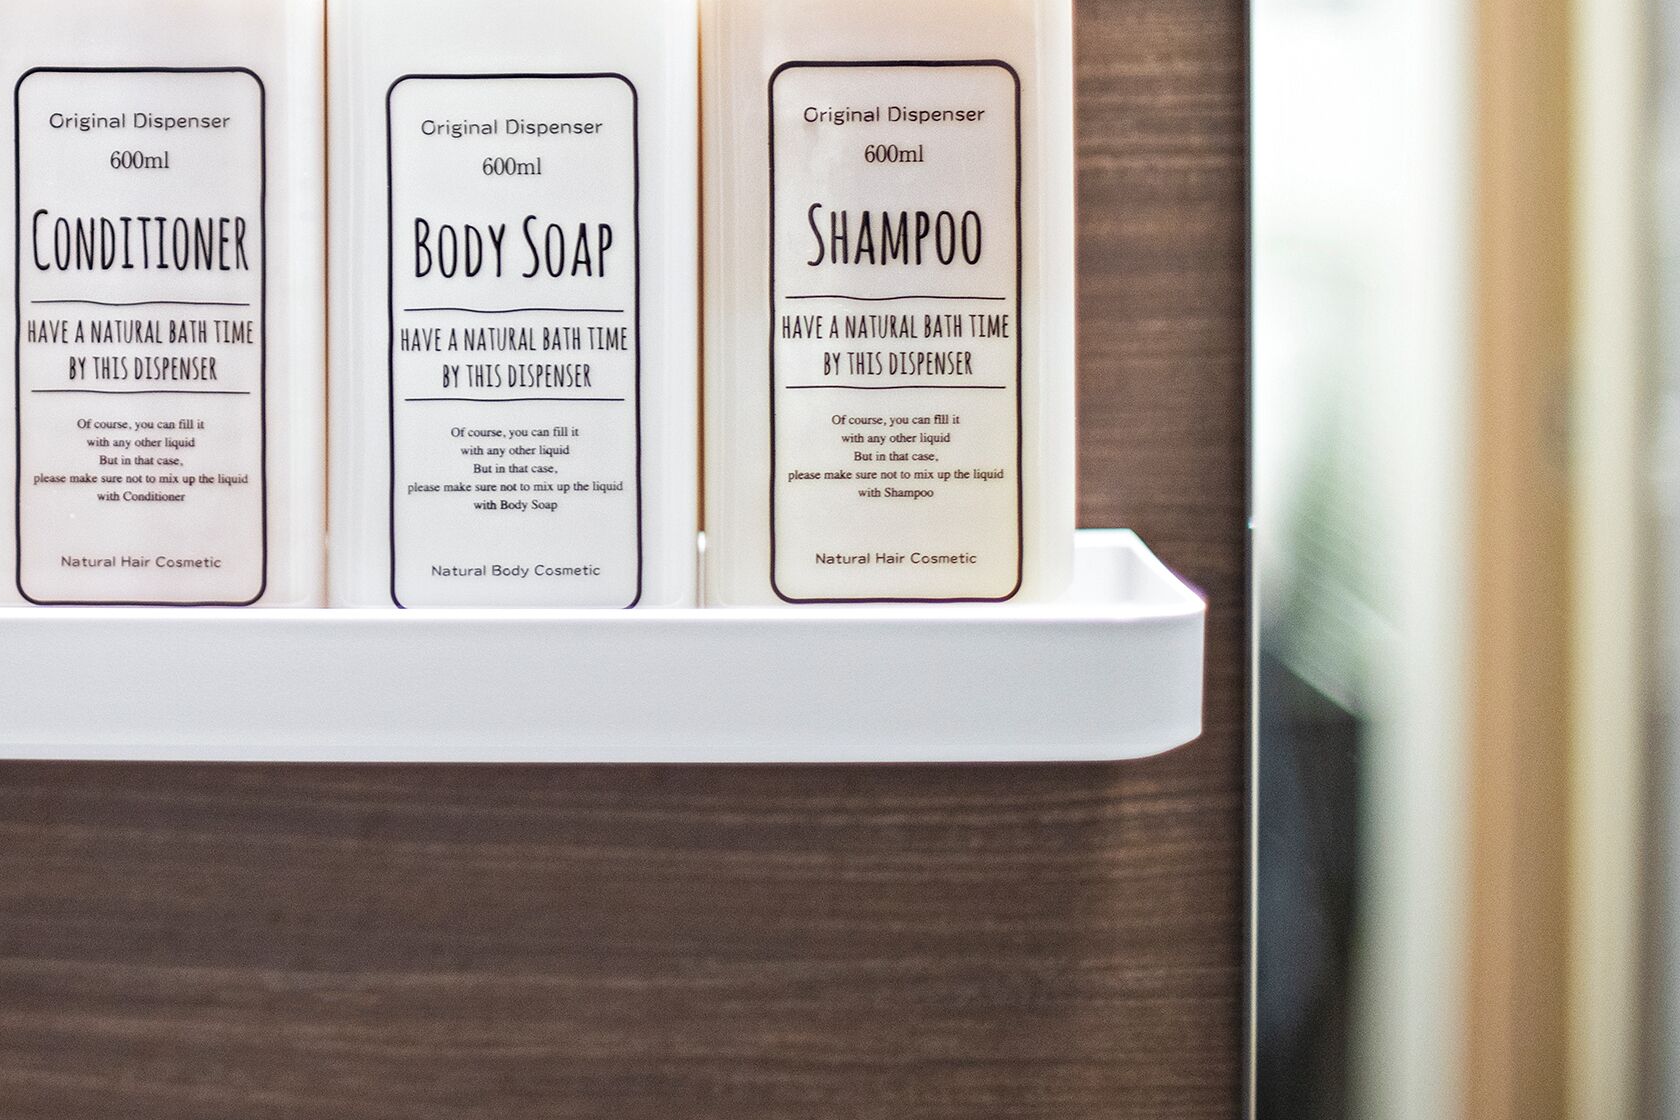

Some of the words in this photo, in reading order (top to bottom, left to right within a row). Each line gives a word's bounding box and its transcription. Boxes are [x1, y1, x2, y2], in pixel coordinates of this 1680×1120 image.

[49, 112, 126, 132] Original
[133, 112, 231, 132] Dispenser
[803, 106, 880, 126] Original
[887, 105, 986, 125] Dispenser
[421, 119, 498, 139] Original
[505, 118, 604, 137] Dispenser
[109, 150, 170, 170] 600ml
[864, 143, 925, 164] 600ml
[482, 156, 542, 176] 600ml
[32, 208, 249, 272] CONDITIONER
[807, 202, 983, 267] SHAMPOO
[414, 217, 506, 279] BODY
[521, 214, 613, 279] SOAP
[27, 319, 69, 344] HAVE
[74, 319, 85, 344] A
[90, 319, 163, 344] NATURAL
[168, 319, 208, 344] BATH
[213, 319, 254, 345] TIME
[782, 315, 823, 340] HAVE
[829, 315, 839, 339] A
[845, 314, 919, 339] NATURAL
[923, 313, 963, 339] BATH
[968, 313, 1010, 339] TIME
[400, 327, 442, 352] HAVE
[447, 327, 458, 352] A
[463, 327, 537, 352] NATURAL
[542, 326, 581, 351] BATH
[587, 326, 628, 351] TIME
[69, 355, 87, 381] BY
[92, 356, 128, 381] THIS
[134, 356, 218, 381] DISPENSER
[823, 351, 841, 376] BY
[846, 351, 883, 376] THIS
[888, 350, 973, 376] DISPENSER
[442, 364, 460, 389] BY
[465, 363, 502, 388] THIS
[507, 363, 592, 388] DISPENSER
[76, 418, 92, 430] Of
[134, 421, 155, 432] you
[156, 421, 176, 430] can
[178, 418, 195, 430] fill
[196, 419, 205, 430] it
[831, 414, 848, 426] Of
[888, 416, 910, 428] you
[911, 416, 931, 425] can
[933, 413, 950, 425] fill
[952, 414, 961, 425] it
[450, 426, 466, 438] Of
[508, 429, 529, 440] you
[530, 429, 550, 437] can
[552, 426, 569, 437] fill
[570, 426, 580, 437] it
[841, 432, 865, 444] with
[866, 435, 887, 446] any
[888, 432, 918, 444] other
[919, 432, 951, 446] liquid
[86, 436, 111, 448] with
[112, 439, 132, 450] any
[134, 436, 163, 448] other
[164, 437, 196, 451] liquid
[460, 445, 485, 456] with
[486, 447, 506, 458] any
[508, 445, 537, 456] other
[538, 444, 571, 458] liquid
[98, 454, 119, 466] But
[120, 454, 132, 466] in
[134, 455, 155, 466] that
[853, 450, 874, 462] But
[875, 450, 887, 462] in
[888, 450, 910, 462] that
[473, 463, 493, 474] But
[495, 463, 506, 474] in
[508, 463, 529, 474] that
[787, 469, 822, 483] please
[823, 469, 853, 480] make
[855, 471, 878, 480] sure
[880, 470, 898, 480] not
[900, 470, 912, 480] to
[913, 468, 935, 480] mix
[936, 471, 952, 482] up
[953, 468, 971, 480] the
[973, 468, 1005, 482] liquid
[33, 472, 67, 486] please
[69, 472, 98, 484] make
[100, 475, 123, 484] sure
[125, 475, 143, 484] not
[145, 474, 157, 484] to
[158, 472, 180, 484] mix
[181, 475, 196, 487] up
[198, 473, 215, 484] the
[217, 473, 249, 487] liquid
[407, 481, 441, 495] please
[443, 481, 472, 492] make
[474, 484, 498, 492] sure
[499, 483, 518, 492] not
[519, 483, 531, 492] to
[533, 483, 554, 492] mix
[556, 483, 571, 495] up
[572, 481, 590, 492] the
[592, 480, 624, 494] liquid
[857, 487, 882, 498] with
[883, 486, 935, 501] Shampoo
[96, 491, 121, 502] with
[122, 490, 186, 502] Conditioner
[473, 499, 498, 511] with
[499, 499, 529, 513] Body
[531, 499, 559, 513] Soap
[60, 555, 116, 568] Natural
[120, 555, 151, 568] Hair
[155, 555, 222, 569] Cosmetic
[815, 552, 871, 565] Natural
[875, 552, 906, 565] Hair
[910, 552, 977, 565] Cosmetic
[431, 564, 487, 577] Natural
[491, 564, 530, 579] Body
[534, 564, 601, 577] Cosmetic
